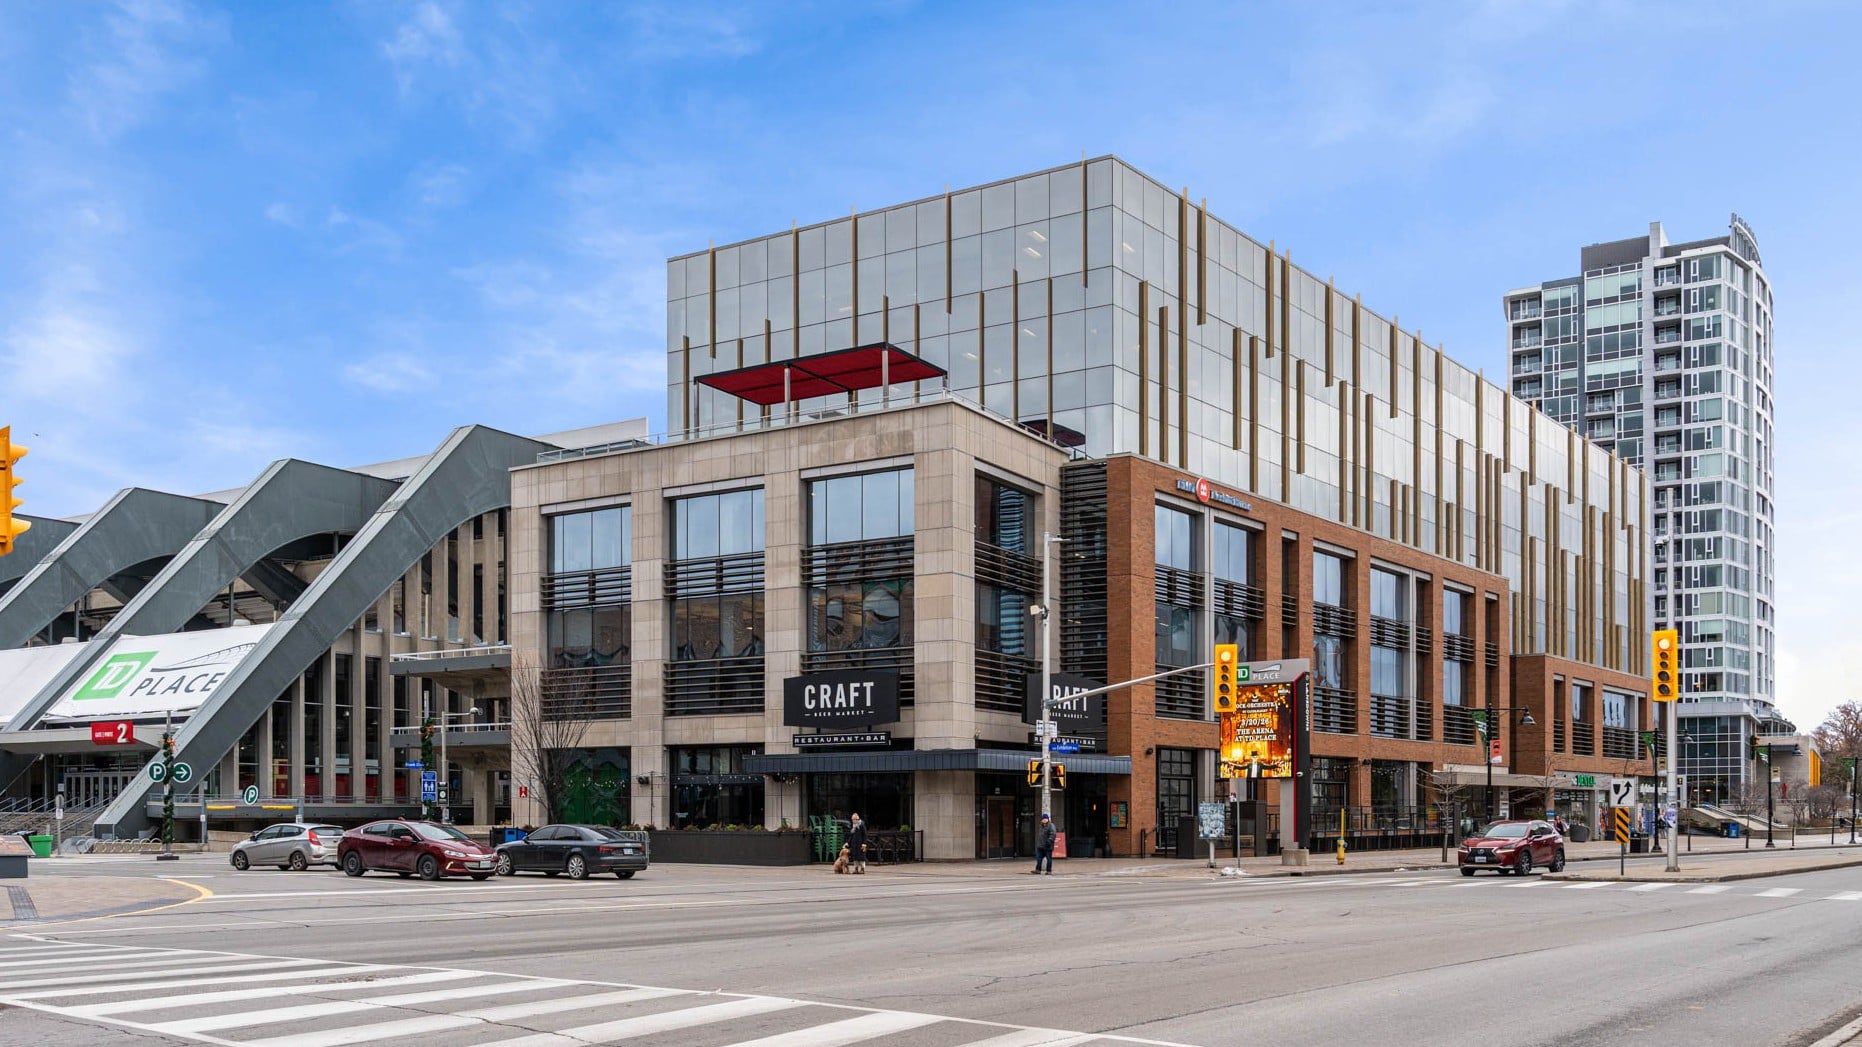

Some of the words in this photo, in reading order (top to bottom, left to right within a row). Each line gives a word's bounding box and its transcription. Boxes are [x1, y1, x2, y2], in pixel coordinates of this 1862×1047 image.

[92, 660, 142, 691] TD
[1237, 668, 1248, 679] TD
[1253, 672, 1280, 680] PLACE
[129, 672, 226, 697] PLACE
[804, 682, 874, 709] CRAFT
[1053, 685, 1089, 711] RAFT
[117, 723, 128, 743] 2
[153, 765, 163, 779] P
[248, 789, 256, 802] P
